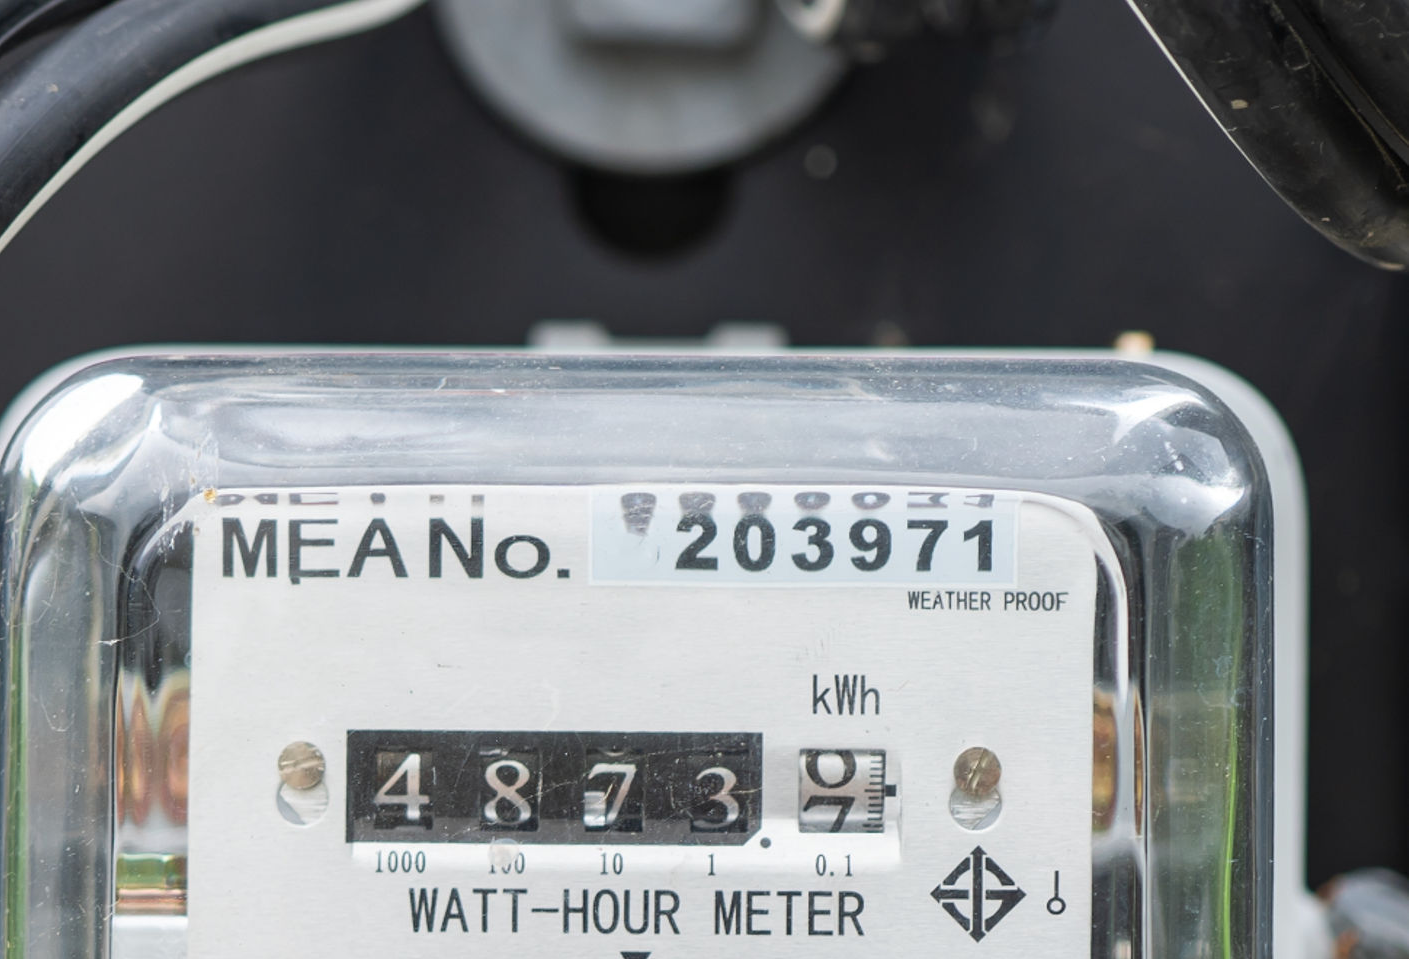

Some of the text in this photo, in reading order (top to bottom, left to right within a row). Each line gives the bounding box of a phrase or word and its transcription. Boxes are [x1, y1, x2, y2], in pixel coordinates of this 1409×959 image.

[222, 517, 570, 585] MEA No.
[676, 516, 992, 571] 203971
[907, 591, 1069, 612] WEATHER PROOF
[812, 674, 880, 716] kWh
[375, 851, 426, 874] 1000
[600, 854, 623, 876] 10
[707, 854, 717, 876] 1
[815, 854, 853, 877] 0.1
[408, 887, 865, 937] WATT-HOUR METER
